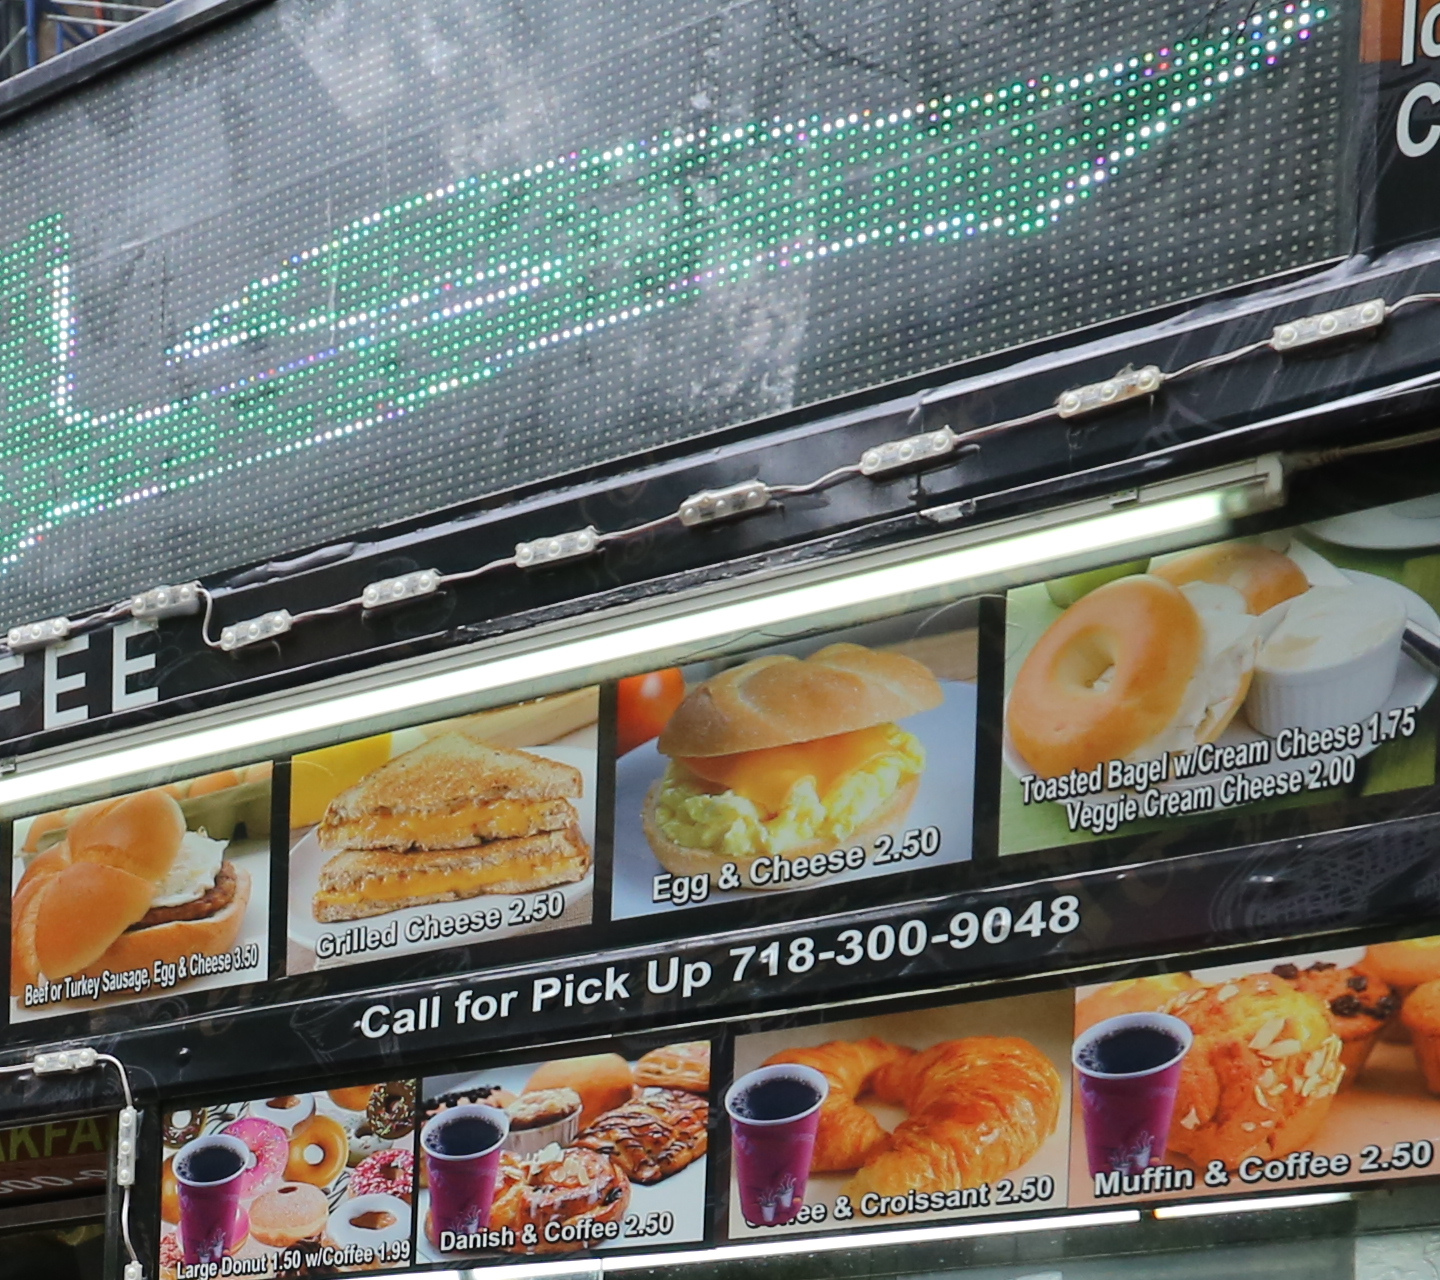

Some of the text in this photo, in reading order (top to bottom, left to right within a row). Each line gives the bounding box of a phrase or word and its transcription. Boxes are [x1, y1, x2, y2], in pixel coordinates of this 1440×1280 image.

[1021, 706, 1416, 806] Toasted Bagel w/Cream Cheese 1.75
[1066, 754, 1356, 835] Veggie Cream Cheese 2.00
[651, 825, 940, 905] Egg & Cheese 2.50
[316, 892, 565, 959] Grilled Cheese 2.50
[25, 944, 259, 1008] Beef or Turkey Sausage, Egg & Cheese 3.50
[360, 893, 1081, 1040] Call for Pick Up 718-300-9048
[1092, 1140, 1433, 1199] Muffin & Coffee 2.50
[221, 1251, 268, 1279] Donut
[271, 1247, 301, 1275] 1.50
[303, 1242, 375, 1272] w/Coffee
[378, 1239, 410, 1266] 1.99
[439, 1211, 674, 1254] Danish & Coffee 2.50
